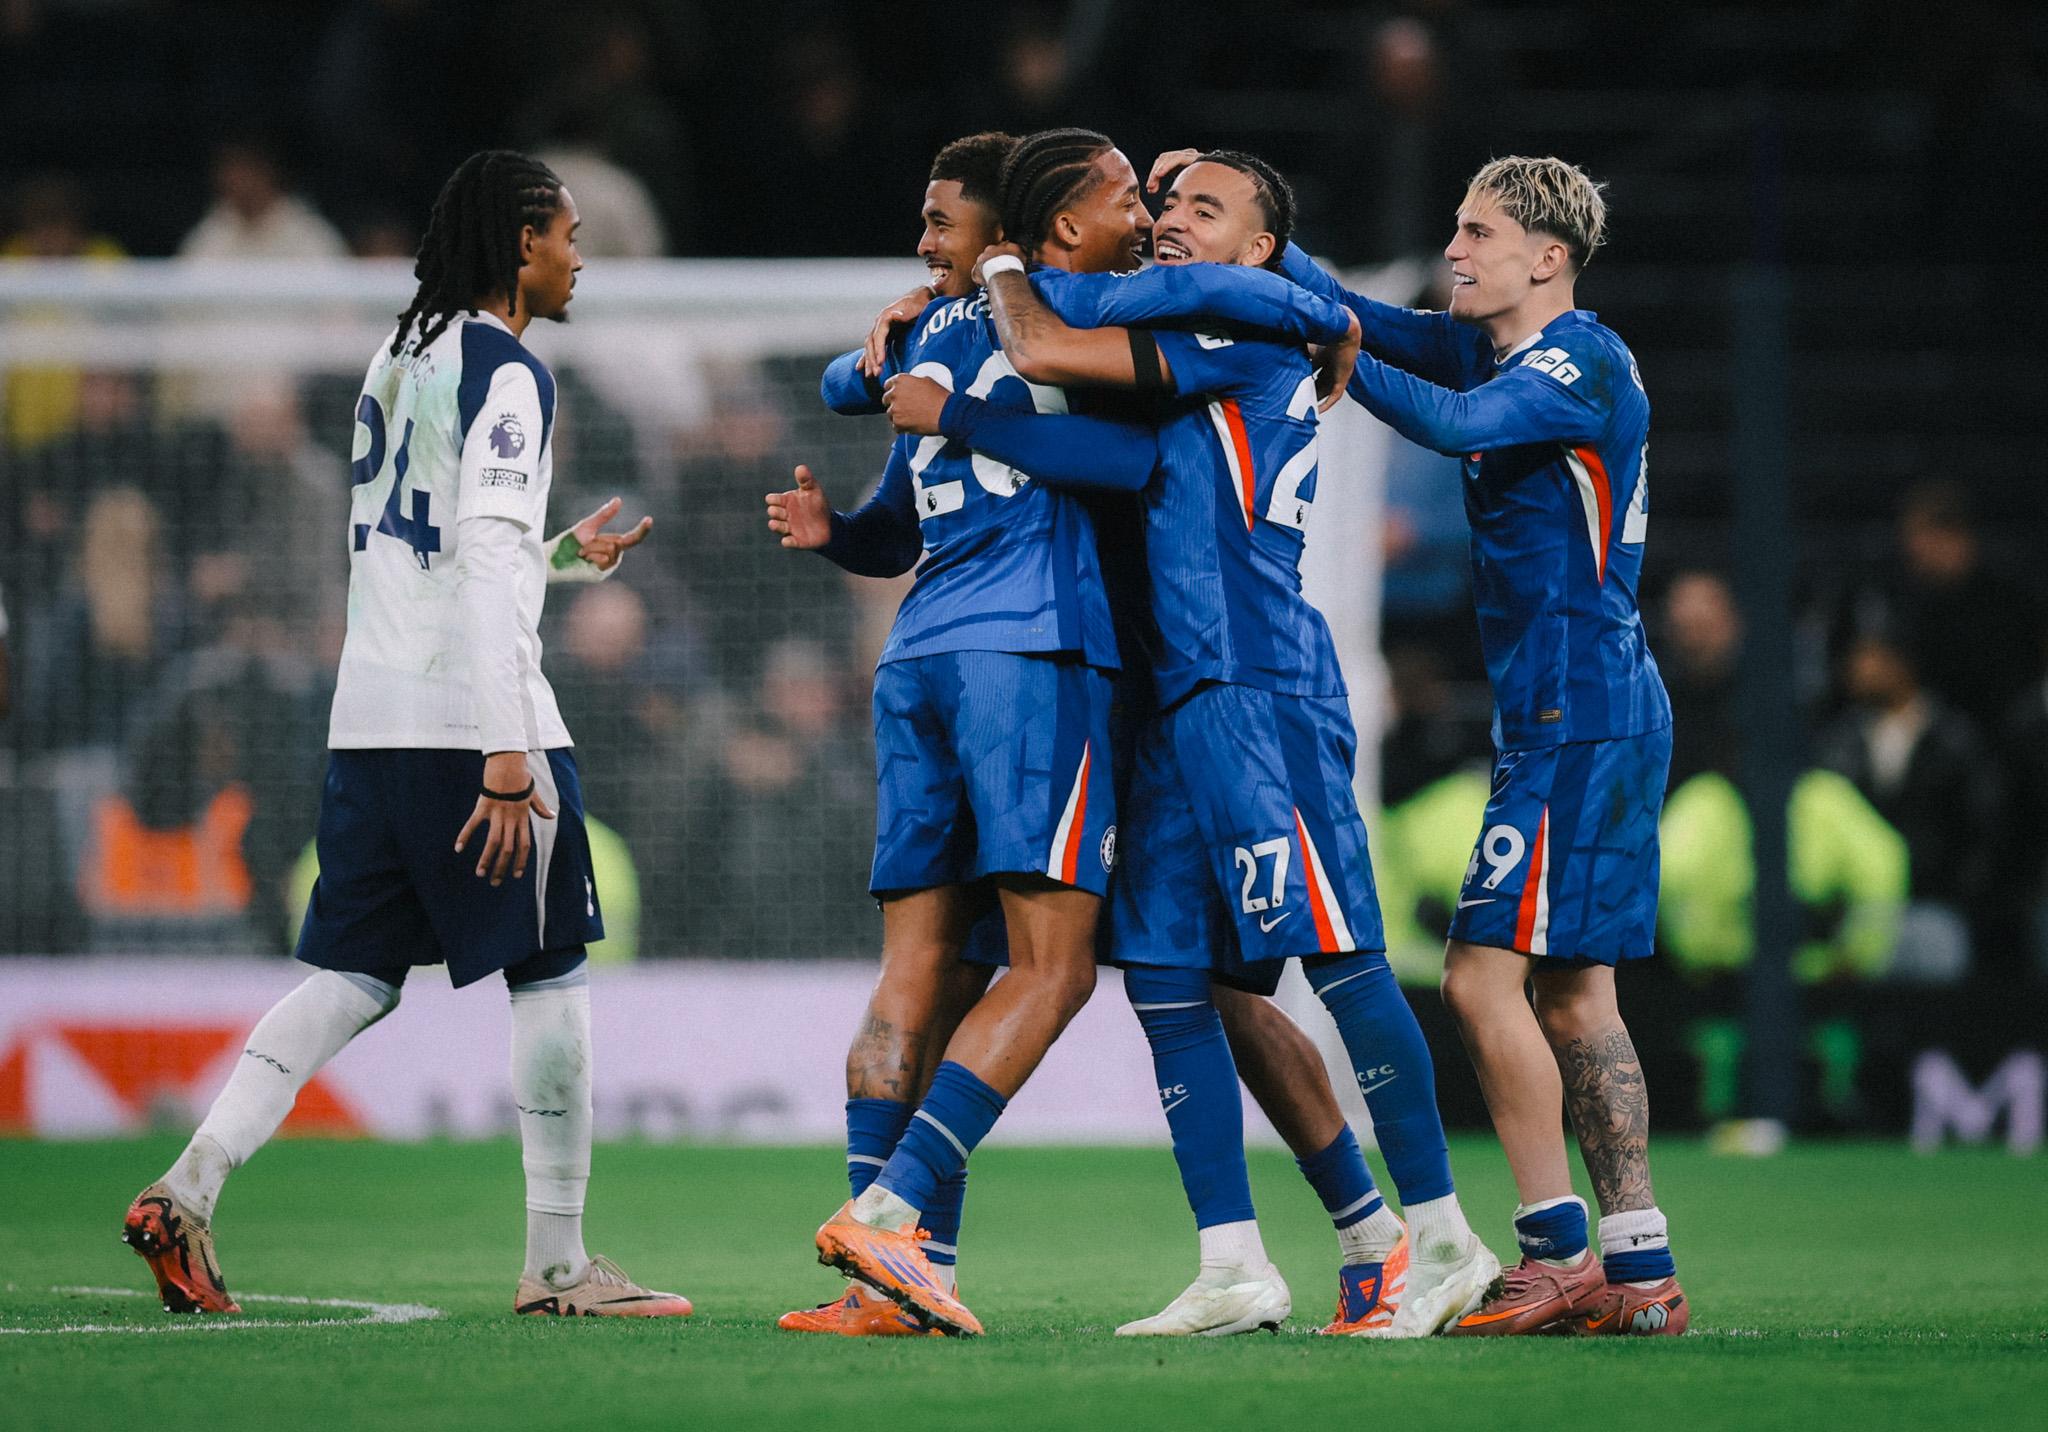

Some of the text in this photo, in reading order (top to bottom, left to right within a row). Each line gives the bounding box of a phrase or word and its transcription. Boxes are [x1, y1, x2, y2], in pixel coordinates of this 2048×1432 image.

[351, 394, 441, 570] 24
[1235, 836, 1291, 914] 27
[1357, 1064, 1395, 1082] CFC
